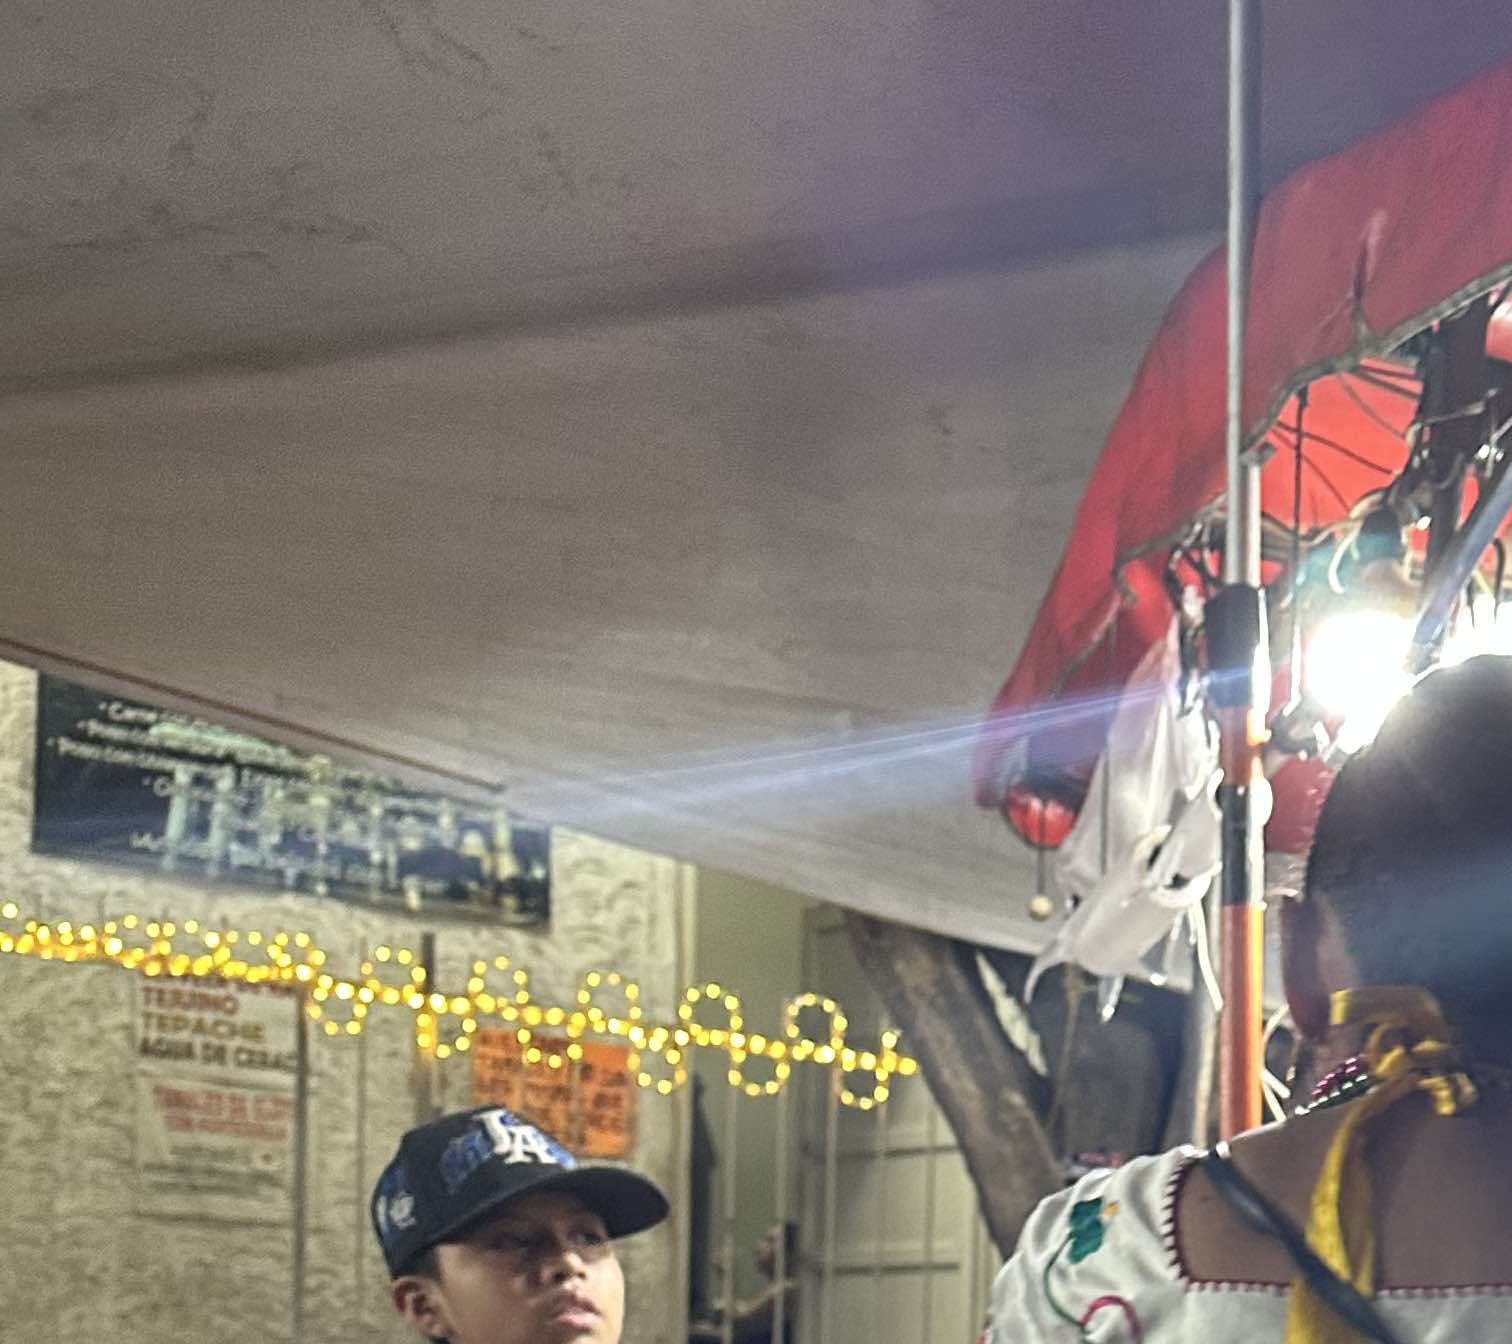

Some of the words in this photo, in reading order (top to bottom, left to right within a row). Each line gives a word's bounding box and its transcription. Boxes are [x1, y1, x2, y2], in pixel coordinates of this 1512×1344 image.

[143, 1011, 266, 1042] TEPACHE
[201, 1041, 227, 1066] DE
[233, 1047, 298, 1074] CEBAD
